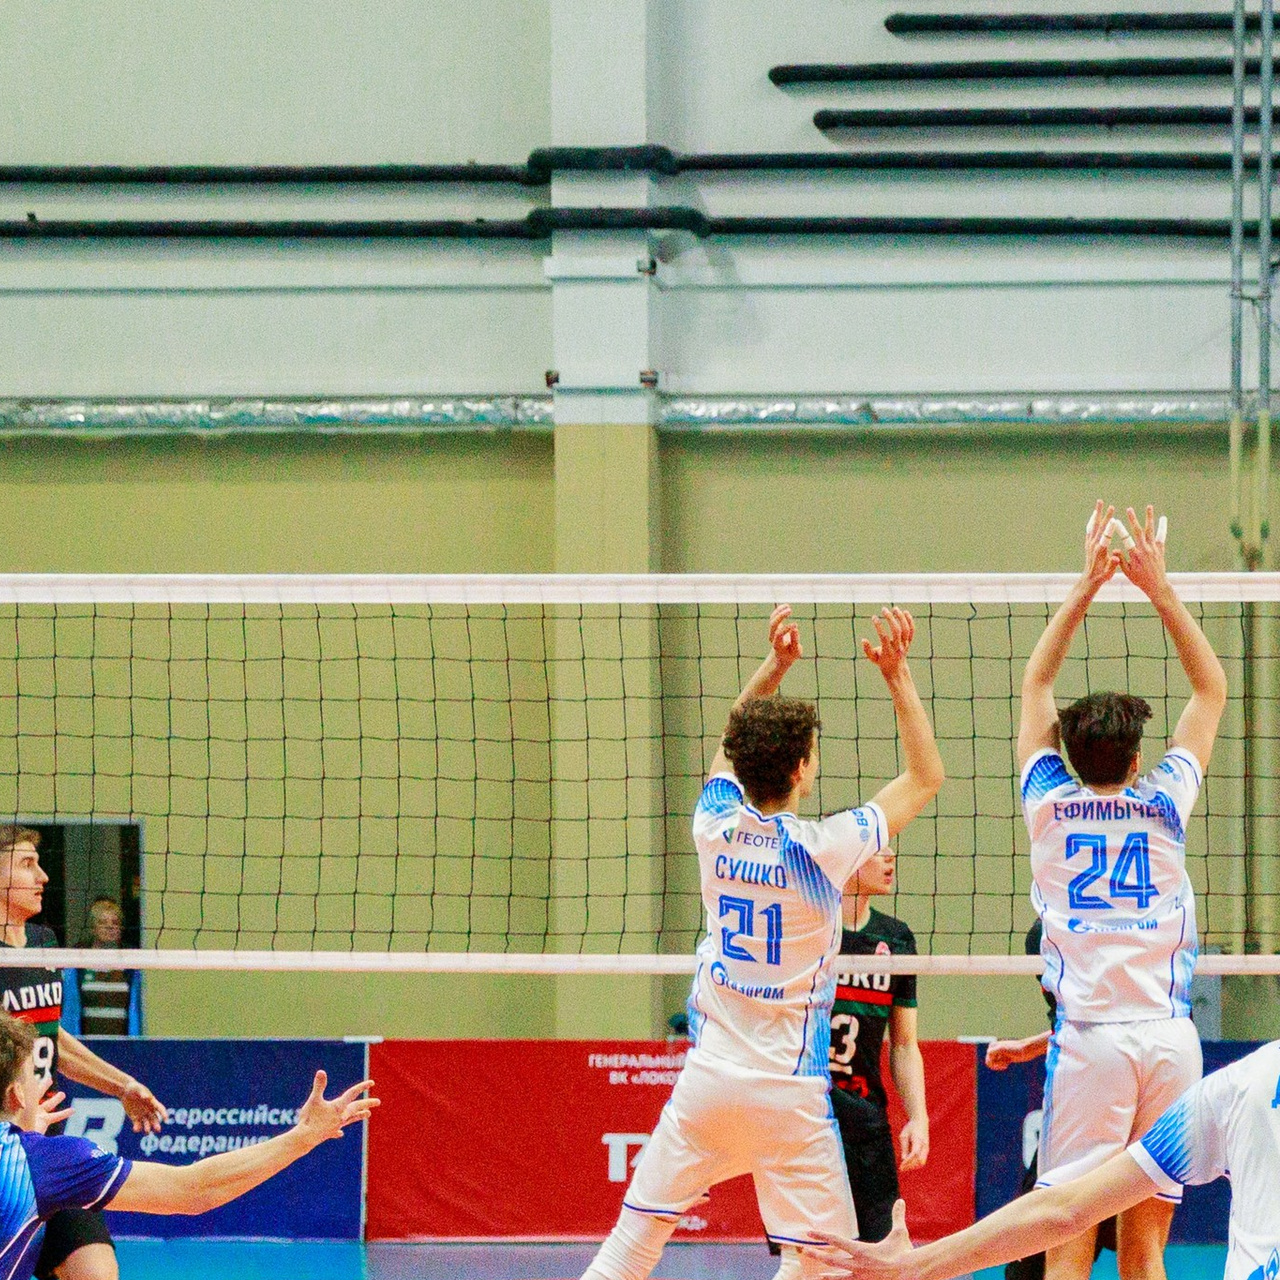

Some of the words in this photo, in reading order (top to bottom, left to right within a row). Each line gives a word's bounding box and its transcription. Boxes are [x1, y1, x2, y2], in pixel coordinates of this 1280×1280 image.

[736, 831, 782, 849] ГЕОТЕ
[715, 854, 788, 889] СУШКО
[1066, 832, 1160, 909] 24
[718, 894, 783, 966] 21
[156, 1104, 301, 1129] сероссийск
